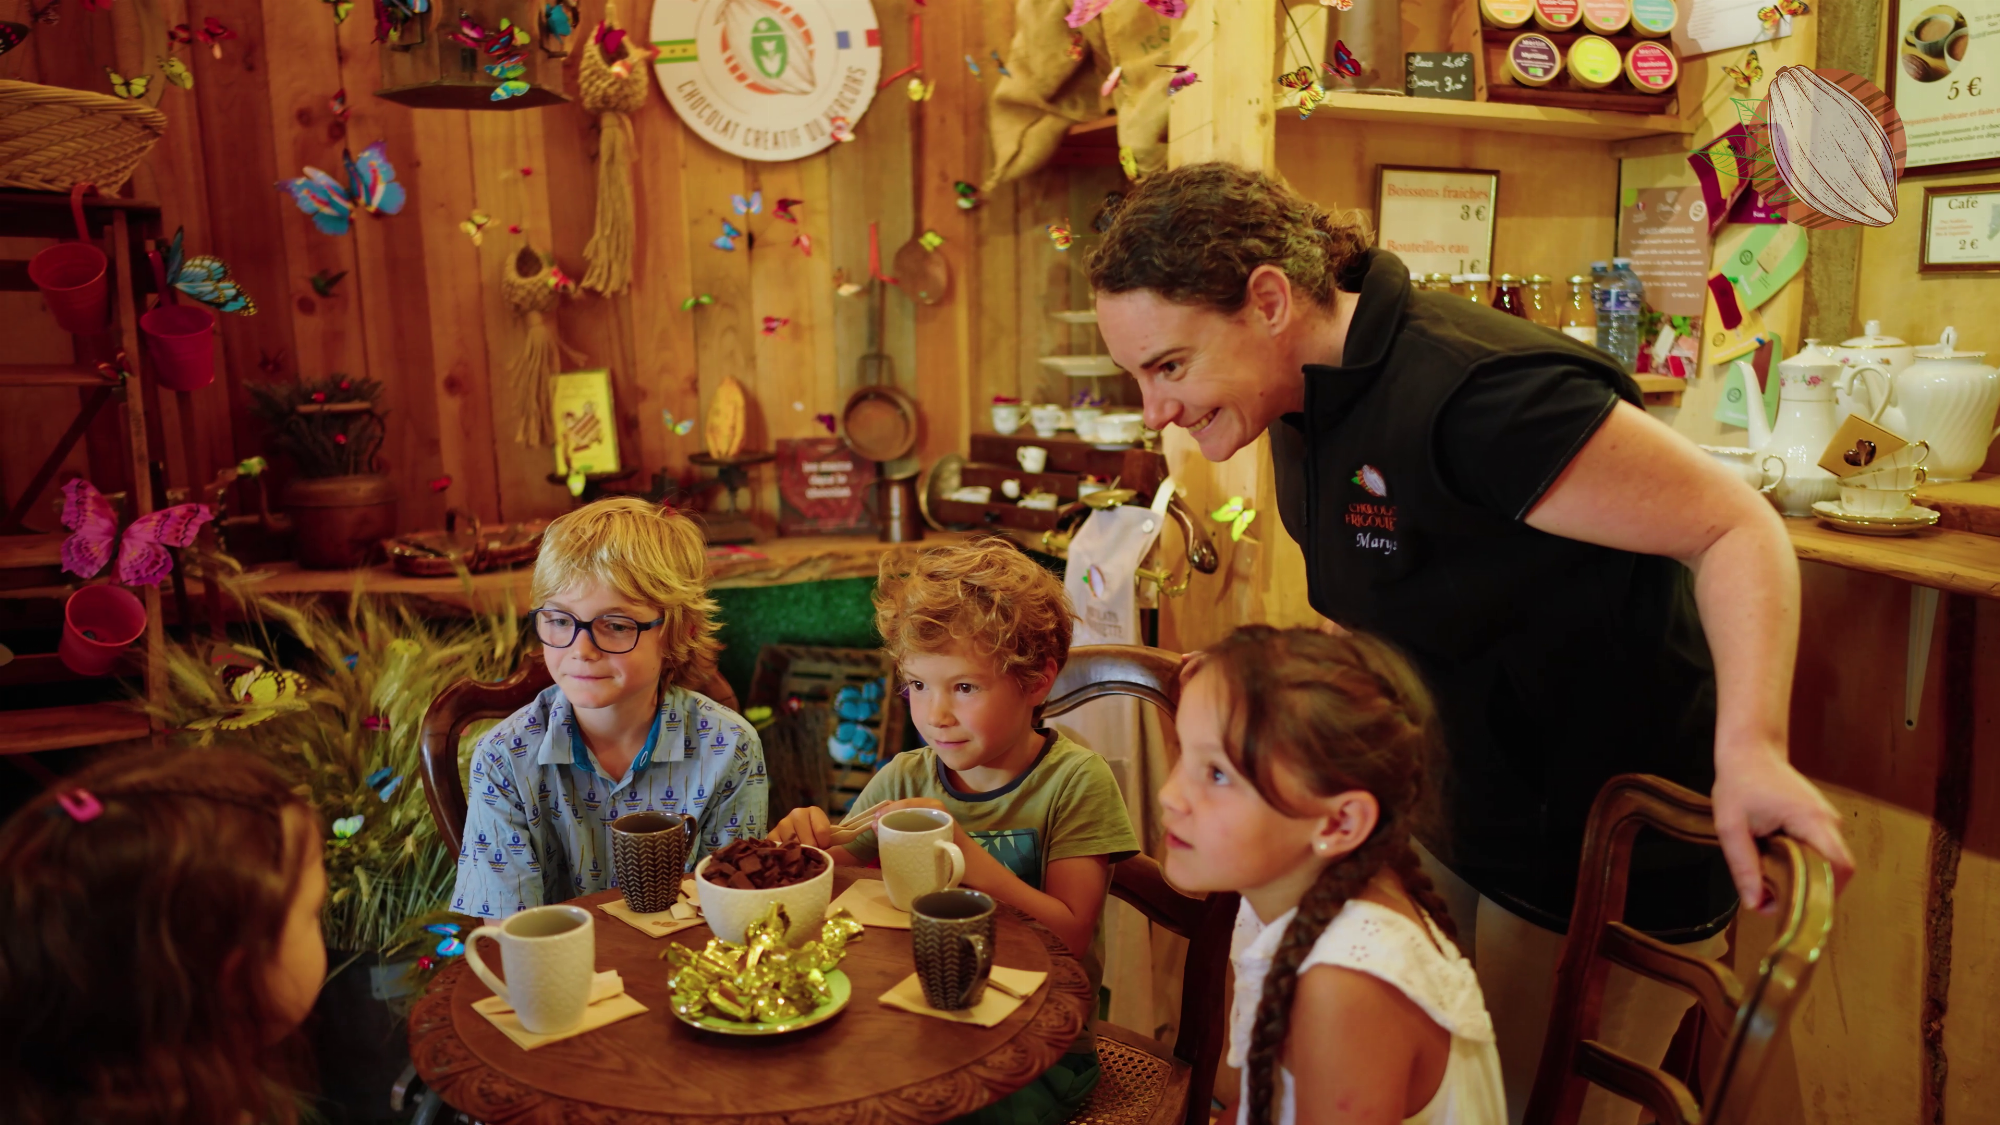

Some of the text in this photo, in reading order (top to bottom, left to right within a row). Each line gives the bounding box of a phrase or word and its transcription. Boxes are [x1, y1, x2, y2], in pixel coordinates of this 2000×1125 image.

[1947, 76, 1982, 100] 5 €
[677, 79, 740, 141] CHOCOLAT
[804, 123, 827, 142] DU
[1387, 183, 1439, 198] Boissons
[1948, 196, 1978, 210] Café
[1460, 204, 1486, 221] 3 €
[1387, 240, 1469, 254] Bouteilles eau
[1959, 238, 1979, 250] 2 €
[1459, 260, 1481, 275] 1 €
